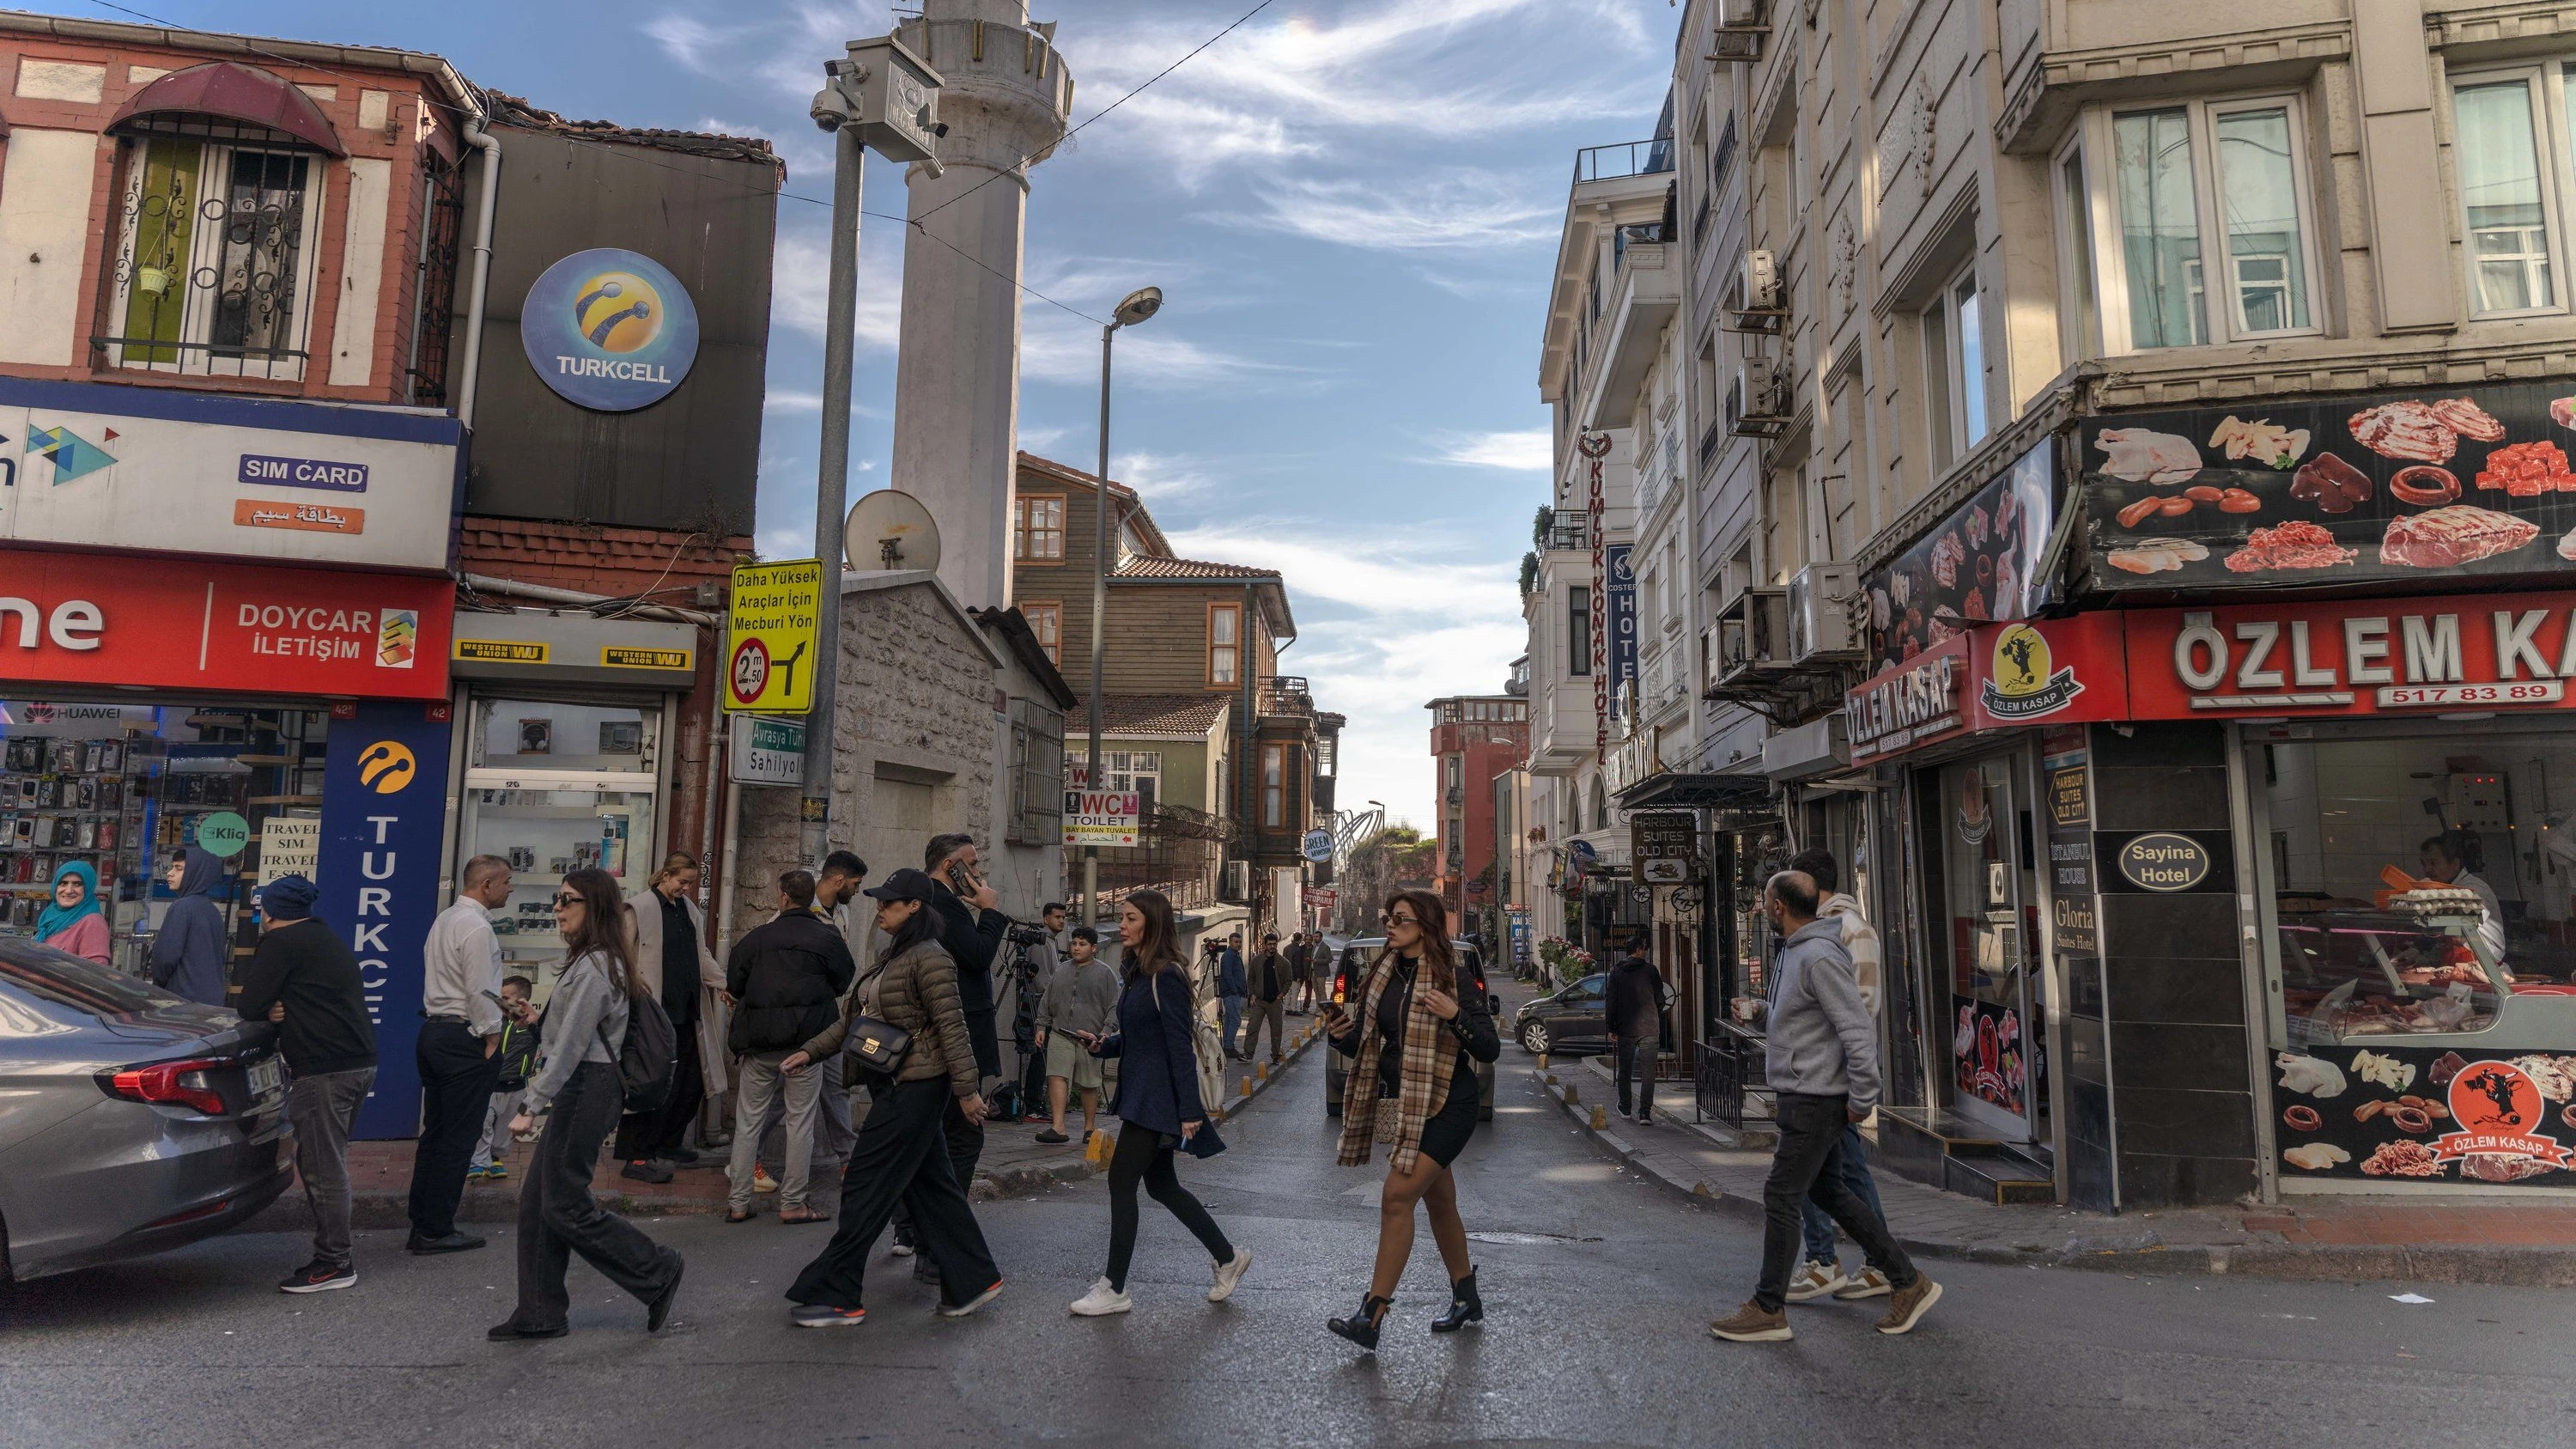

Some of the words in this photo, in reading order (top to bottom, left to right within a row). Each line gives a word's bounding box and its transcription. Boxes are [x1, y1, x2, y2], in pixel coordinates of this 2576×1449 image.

[556, 356, 671, 384] TURKCELL
[246, 460, 289, 479] SIM
[295, 463, 363, 485] CARD
[252, 508, 289, 526] سيم
[295, 505, 346, 528] بطاقة
[1588, 461, 1604, 569] KUMLUK
[737, 573, 767, 588] Daha
[771, 569, 817, 585] Yüksek
[738, 594, 785, 611] Araçlar
[787, 588, 811, 609] İçin
[239, 604, 372, 634] DOYCAR
[734, 615, 784, 630] Mecburi
[788, 614, 812, 629] Yön
[1592, 575, 1606, 667] KONAK
[1619, 594, 1633, 679] HOTE
[252, 632, 361, 661] İLETİŞİM
[464, 643, 508, 652] WESTERN
[513, 646, 538, 659] WU
[610, 650, 653, 659] WESTERN
[2173, 612, 2464, 691] ÖZLEM
[657, 653, 681, 666] WU
[1893, 655, 1952, 728] KASAP
[2392, 689, 2448, 703] 517
[2460, 686, 2497, 701] 83
[2510, 685, 2549, 699] 89
[1993, 697, 2020, 711] ÖZLEM
[2022, 692, 2057, 710] KASAP
[58, 708, 120, 719] HUAWEI
[432, 709, 445, 717] 42
[1594, 674, 1607, 765] HOTEL
[753, 724, 786, 748] Avrasya
[788, 728, 805, 746] Tün
[1893, 736, 1900, 746] 83
[1901, 734, 1909, 743] 89
[2056, 774, 2084, 789] HARBOUR
[2059, 788, 2081, 803] SUITES
[1082, 794, 1121, 815] WC
[2057, 805, 2069, 818] OLD
[2071, 801, 2085, 816] CITY
[1071, 816, 1127, 825] TOILET
[1634, 817, 1692, 827] HARBOUR
[216, 827, 246, 841] Kliq
[264, 825, 321, 835] TRAVEL
[1643, 831, 1685, 842] SUITES
[278, 839, 305, 849] SIM
[1305, 835, 1330, 850] GREEN
[1637, 845, 1661, 856] OLD
[1667, 844, 1692, 856] CITY
[262, 855, 319, 866] TRAVEL
[2131, 845, 2196, 863] Sayina
[2058, 868, 2087, 885] HOUSE
[2141, 868, 2190, 882] Hotel
[1303, 894, 1333, 904] OTOPARK
[2056, 899, 2094, 929] Gloria
[2057, 933, 2076, 948] Suites
[2076, 935, 2095, 951] Hotel
[354, 817, 398, 1097] TURKC
[2454, 1135, 2496, 1152] ÖZLEM
[2500, 1136, 2543, 1154] KASAP
